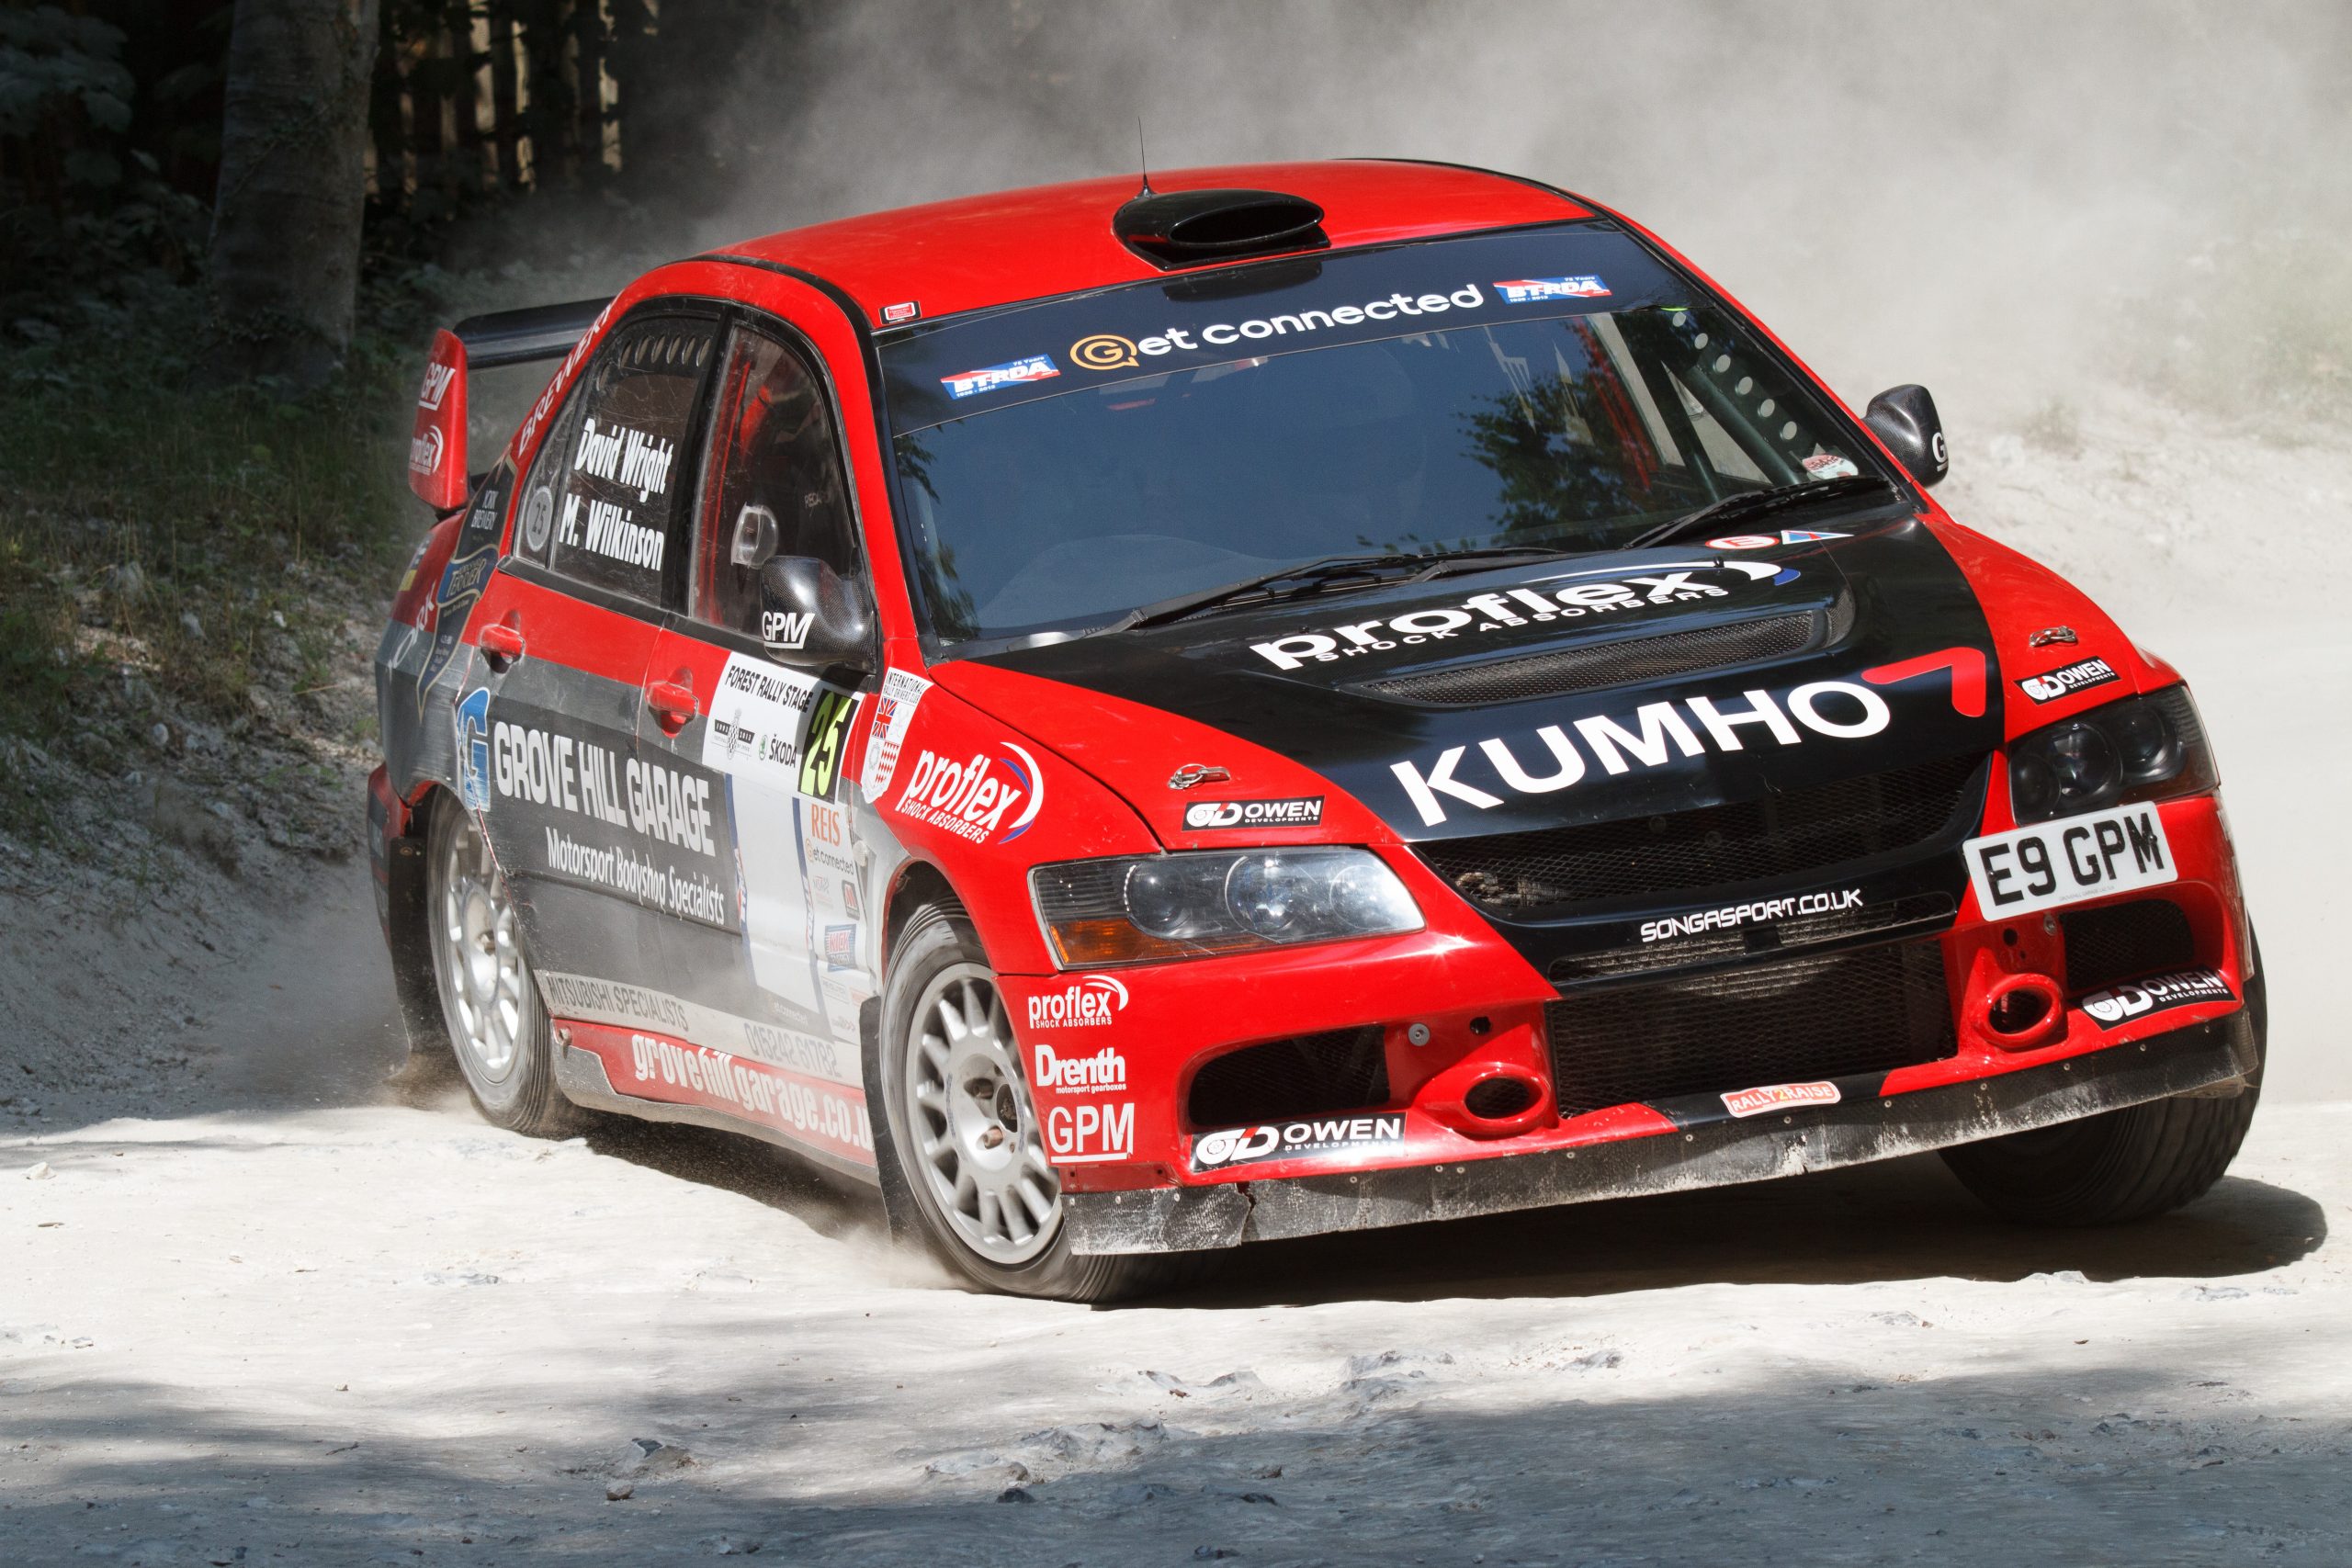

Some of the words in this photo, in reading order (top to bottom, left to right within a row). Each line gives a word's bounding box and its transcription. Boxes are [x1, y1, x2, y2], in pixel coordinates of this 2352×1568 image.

[1507, 281, 1604, 299] BTRDA
[1075, 327, 1199, 367] Get
[1202, 284, 1485, 344] connected
[420, 361, 457, 403] GPM
[518, 302, 613, 458] BREWERY
[953, 360, 1054, 393] BTRDA
[574, 417, 627, 480] David
[619, 429, 674, 503] Wright
[559, 492, 581, 547] M.
[585, 499, 665, 571] Wilkinson
[762, 610, 816, 646] GPM
[1249, 571, 1720, 671] proflex
[1315, 629, 1459, 662] SHOCK
[1479, 586, 1729, 632] ABSORBERS
[725, 664, 761, 695] FOREST
[757, 676, 786, 704] RALLY
[783, 684, 814, 714] STAGE
[2056, 659, 2112, 684] OWEN
[2068, 671, 2116, 689] DEVELOPMENTS
[768, 733, 798, 769] ŠKODA
[799, 690, 853, 796] 25
[1388, 681, 1892, 827] KUMHO
[493, 721, 579, 813] GROVE
[578, 740, 628, 828] HILL
[626, 757, 717, 857] GARAGE
[894, 750, 1023, 831] proflex
[1244, 799, 1321, 818] OWEN
[810, 803, 841, 847] REIS
[900, 798, 933, 822] SHOCK
[927, 809, 990, 844] ABSORBERS
[545, 826, 615, 886] Motorsport
[616, 846, 667, 915] Bodyshop
[669, 865, 725, 925] Specialists
[820, 850, 854, 875] connected
[1978, 835, 2057, 907] E9
[2063, 812, 2165, 886] GPM
[1640, 888, 1864, 943] SONGASPORT.CO.UK
[547, 976, 616, 1013] MITSUBISHI
[613, 986, 689, 1032] SPECIALISTS
[2141, 970, 2224, 996] OWEN
[2158, 987, 2229, 1003] DEVELOPMENTS
[1028, 986, 1112, 1029] proflex
[1035, 1019, 1060, 1029] SHOCK
[1063, 1016, 1113, 1028] ABSORBERS
[1035, 1043, 1125, 1087] Drenth
[631, 1032, 875, 1152] grovehillgarage.co.u
[1056, 1084, 1091, 1095] motorsport
[1091, 1083, 1127, 1094] gearboxes
[1731, 1085, 1834, 1111] RALLY2RAISE
[1047, 1102, 1136, 1156] GPM
[1283, 1118, 1400, 1144] OWEN
[1284, 1140, 1398, 1152] DEVELOPMENTS
